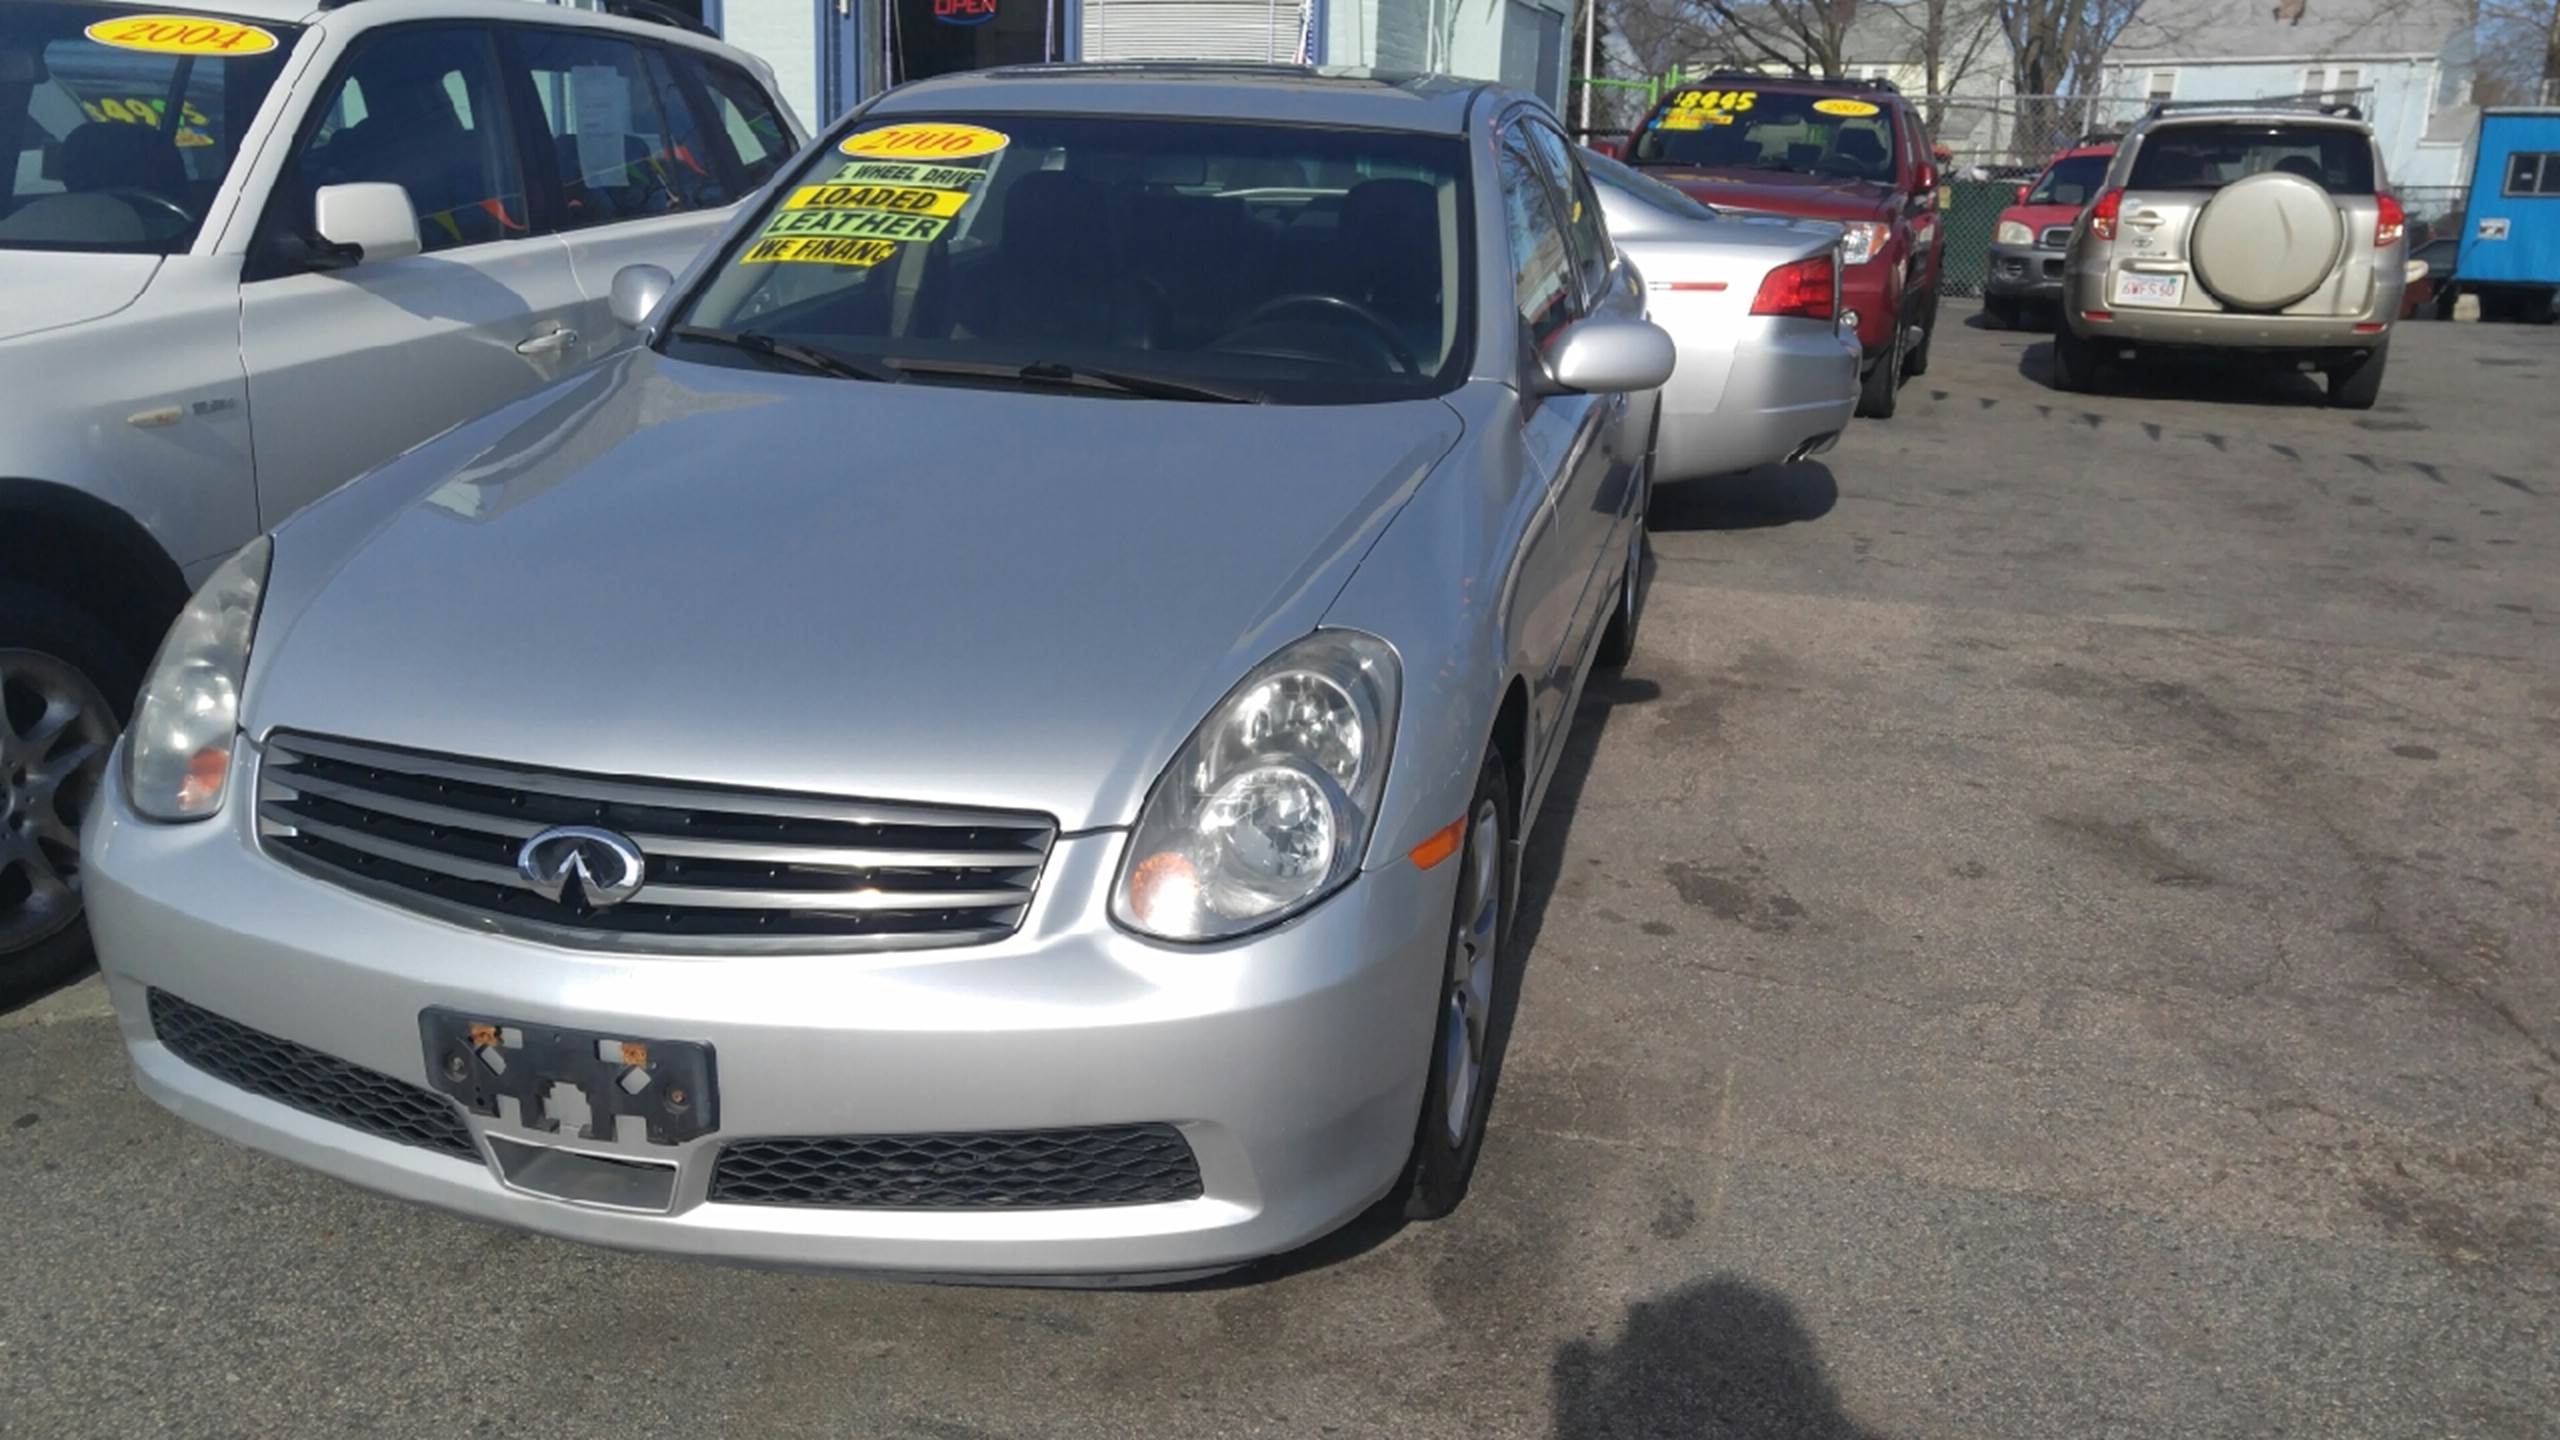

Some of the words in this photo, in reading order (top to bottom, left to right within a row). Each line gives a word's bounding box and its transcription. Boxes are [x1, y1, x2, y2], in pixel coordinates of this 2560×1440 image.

[934, 0, 996, 15] OPEN
[112, 22, 248, 49] 2004
[857, 130, 981, 152] 2006
[853, 164, 920, 181] WHEEL
[804, 187, 939, 210] LOADED
[767, 212, 939, 239] LEATHER
[751, 239, 791, 259] WE
